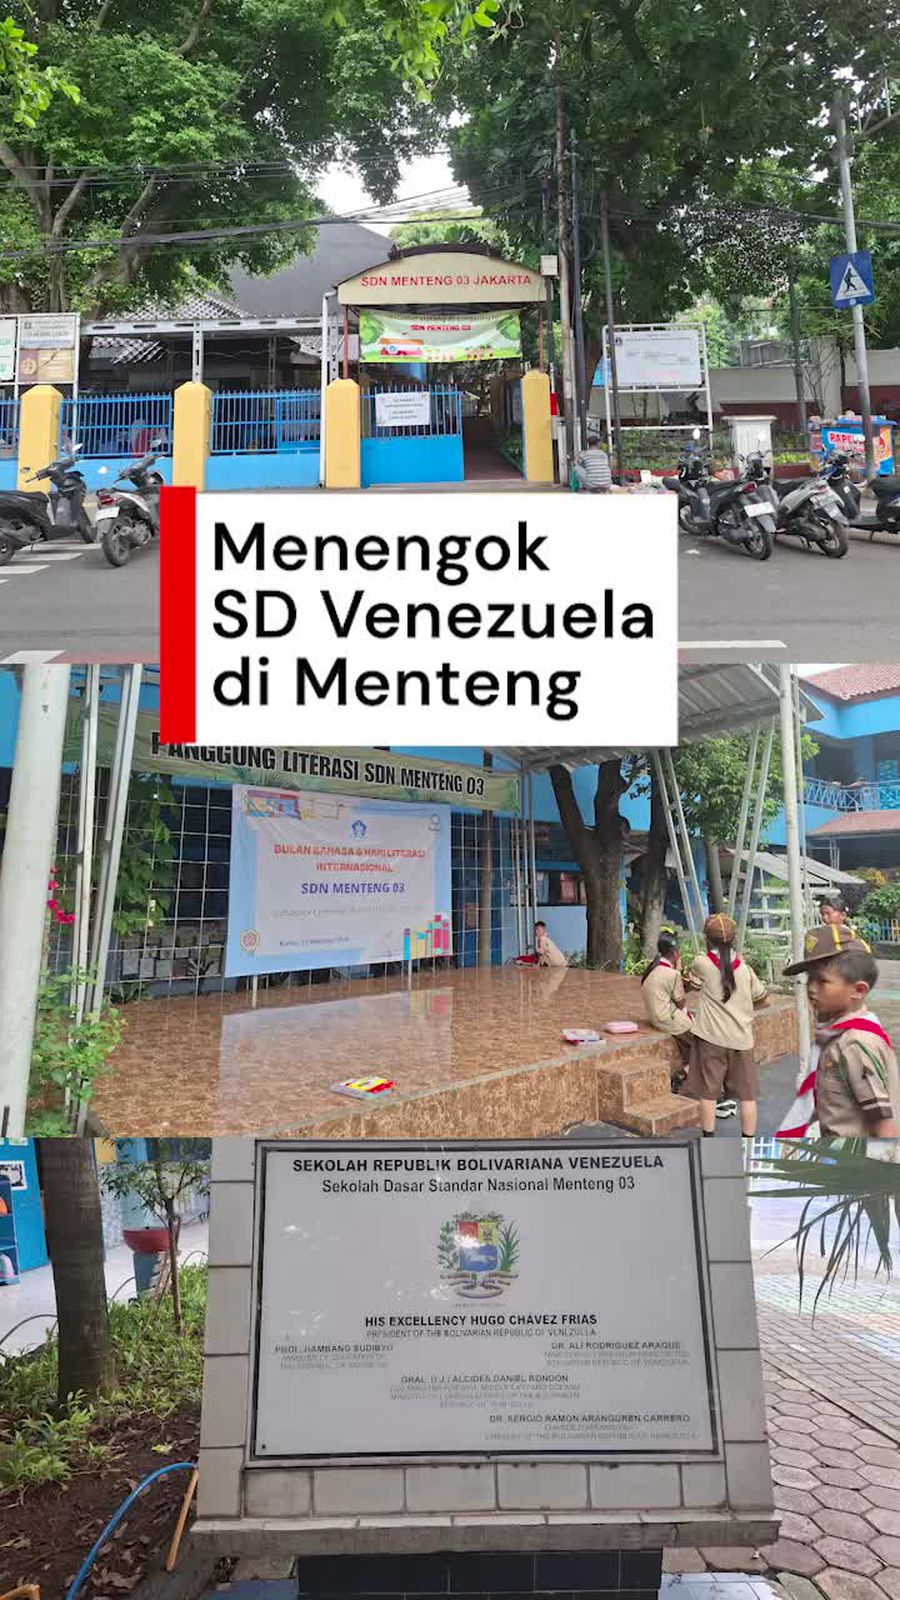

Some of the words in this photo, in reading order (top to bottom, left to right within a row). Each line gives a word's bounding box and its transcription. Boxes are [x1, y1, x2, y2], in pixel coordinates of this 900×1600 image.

[361, 276, 388, 287] SDN
[391, 275, 453, 287] MENTENG
[456, 275, 470, 286] 03
[474, 274, 531, 286] JAKARTA
[283, 750, 359, 781] LITERASI
[364, 762, 396, 786] SDN
[400, 768, 463, 793] MENTENG
[466, 776, 485, 796] 03
[274, 844, 311, 855] BULAN
[316, 862, 394, 872] INTERNASIONAL
[301, 883, 329, 894] SDN
[332, 883, 390, 894] MENTENG
[392, 883, 405, 893] 03
[293, 1159, 368, 1172] SEKOLAH
[372, 1159, 452, 1172] REPUBLIK
[456, 1157, 564, 1171] BOLIVARIANA
[568, 1155, 664, 1169] VENEZUELA
[322, 1179, 379, 1193] Sekolah
[383, 1179, 424, 1193] Dasar
[428, 1178, 484, 1192] Standar
[487, 1177, 548, 1191] Nasional
[553, 1177, 614, 1193] Menteng
[618, 1175, 635, 1189] 03
[365, 1316, 386, 1327] HIS
[389, 1315, 467, 1327] EXCELLENCY
[470, 1315, 506, 1326] HUGO
[561, 1314, 598, 1325] FRIAS
[366, 1330, 411, 1338] PRESIDENT
[569, 1341, 584, 1349] ALI
